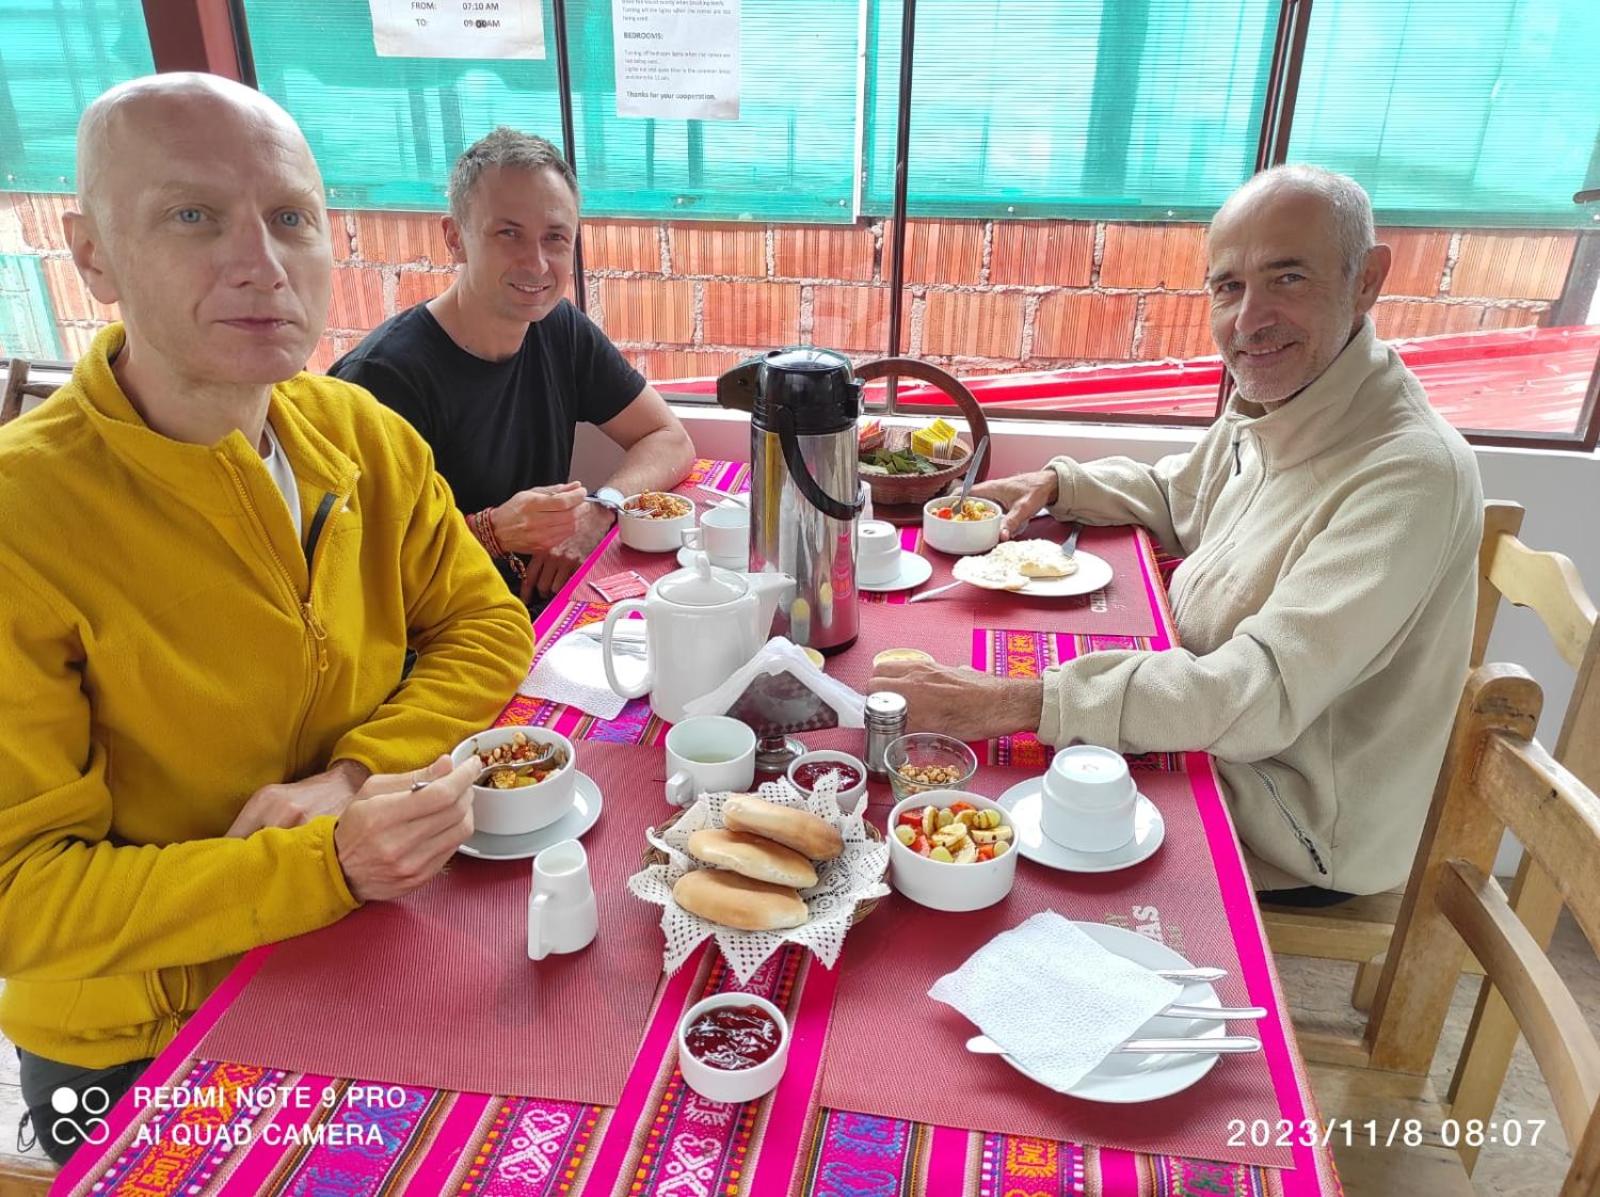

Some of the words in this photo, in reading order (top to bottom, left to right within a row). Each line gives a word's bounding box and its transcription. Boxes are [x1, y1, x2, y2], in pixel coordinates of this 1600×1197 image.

[411, 1, 437, 10] FROM:
[462, 2, 484, 11] 07:10
[485, 2, 500, 11] AM
[623, 31, 664, 40] BEDROOMS:
[626, 90, 649, 98] Thanks
[660, 92, 674, 101] your
